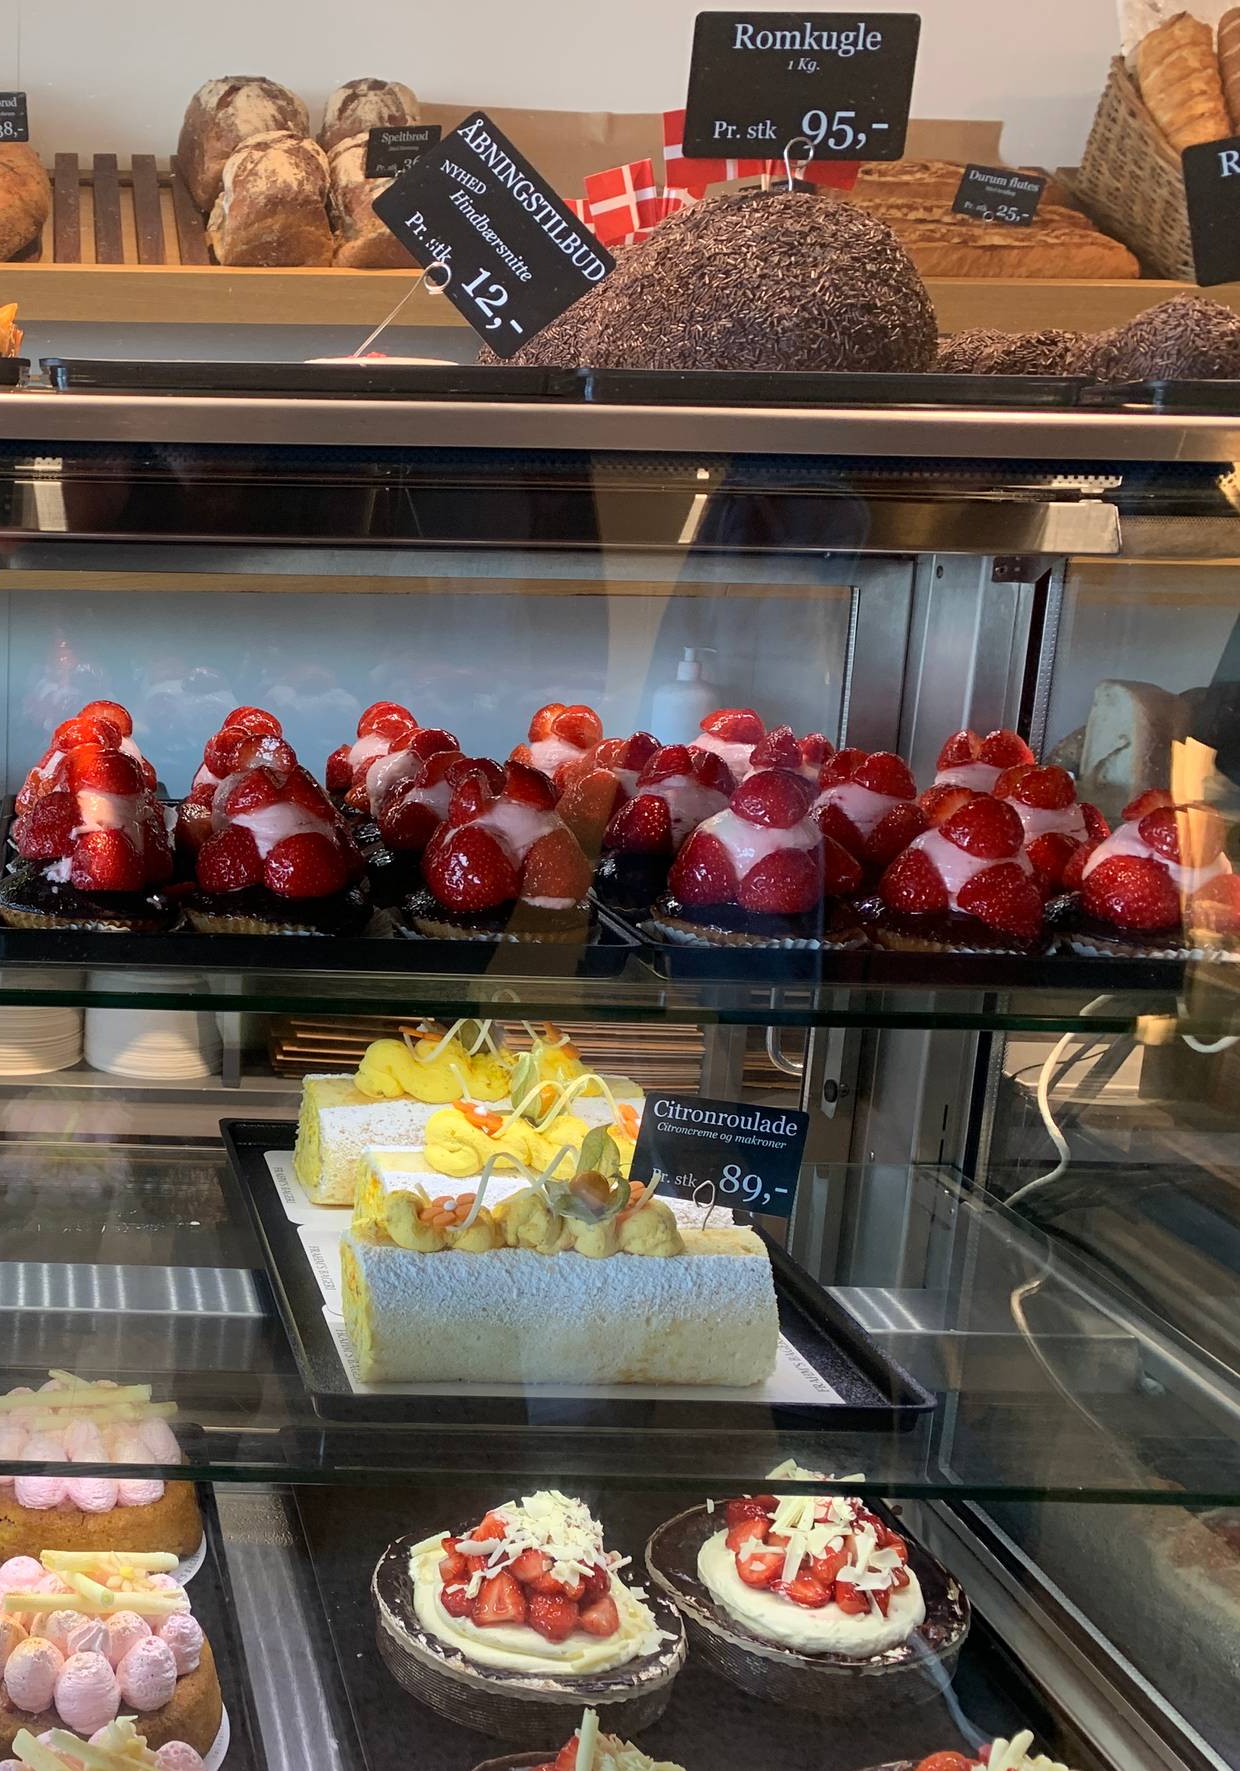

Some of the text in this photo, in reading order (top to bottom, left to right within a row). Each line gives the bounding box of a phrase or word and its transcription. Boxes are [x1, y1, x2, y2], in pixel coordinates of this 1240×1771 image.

[732, 22, 882, 57] Romkugle
[787, 58, 820, 73] 1 Kg.
[713, 109, 889, 150] Pr. stk 95,-
[440, 159, 487, 194] NYHED
[969, 170, 1007, 186] Durum
[1008, 177, 1040, 192] flutes
[457, 119, 607, 281] ÅBNINGSTILBUD
[996, 205, 1029, 222] 25,-
[449, 189, 533, 282] Hindbærsnitte
[405, 211, 523, 334] Pr. stk 12,-
[654, 1099, 798, 1136] Citronroulade
[657, 1121, 787, 1149] Citroncreme og makroner
[675, 1173, 698, 1188] stk
[719, 1164, 788, 1205] 89,-
